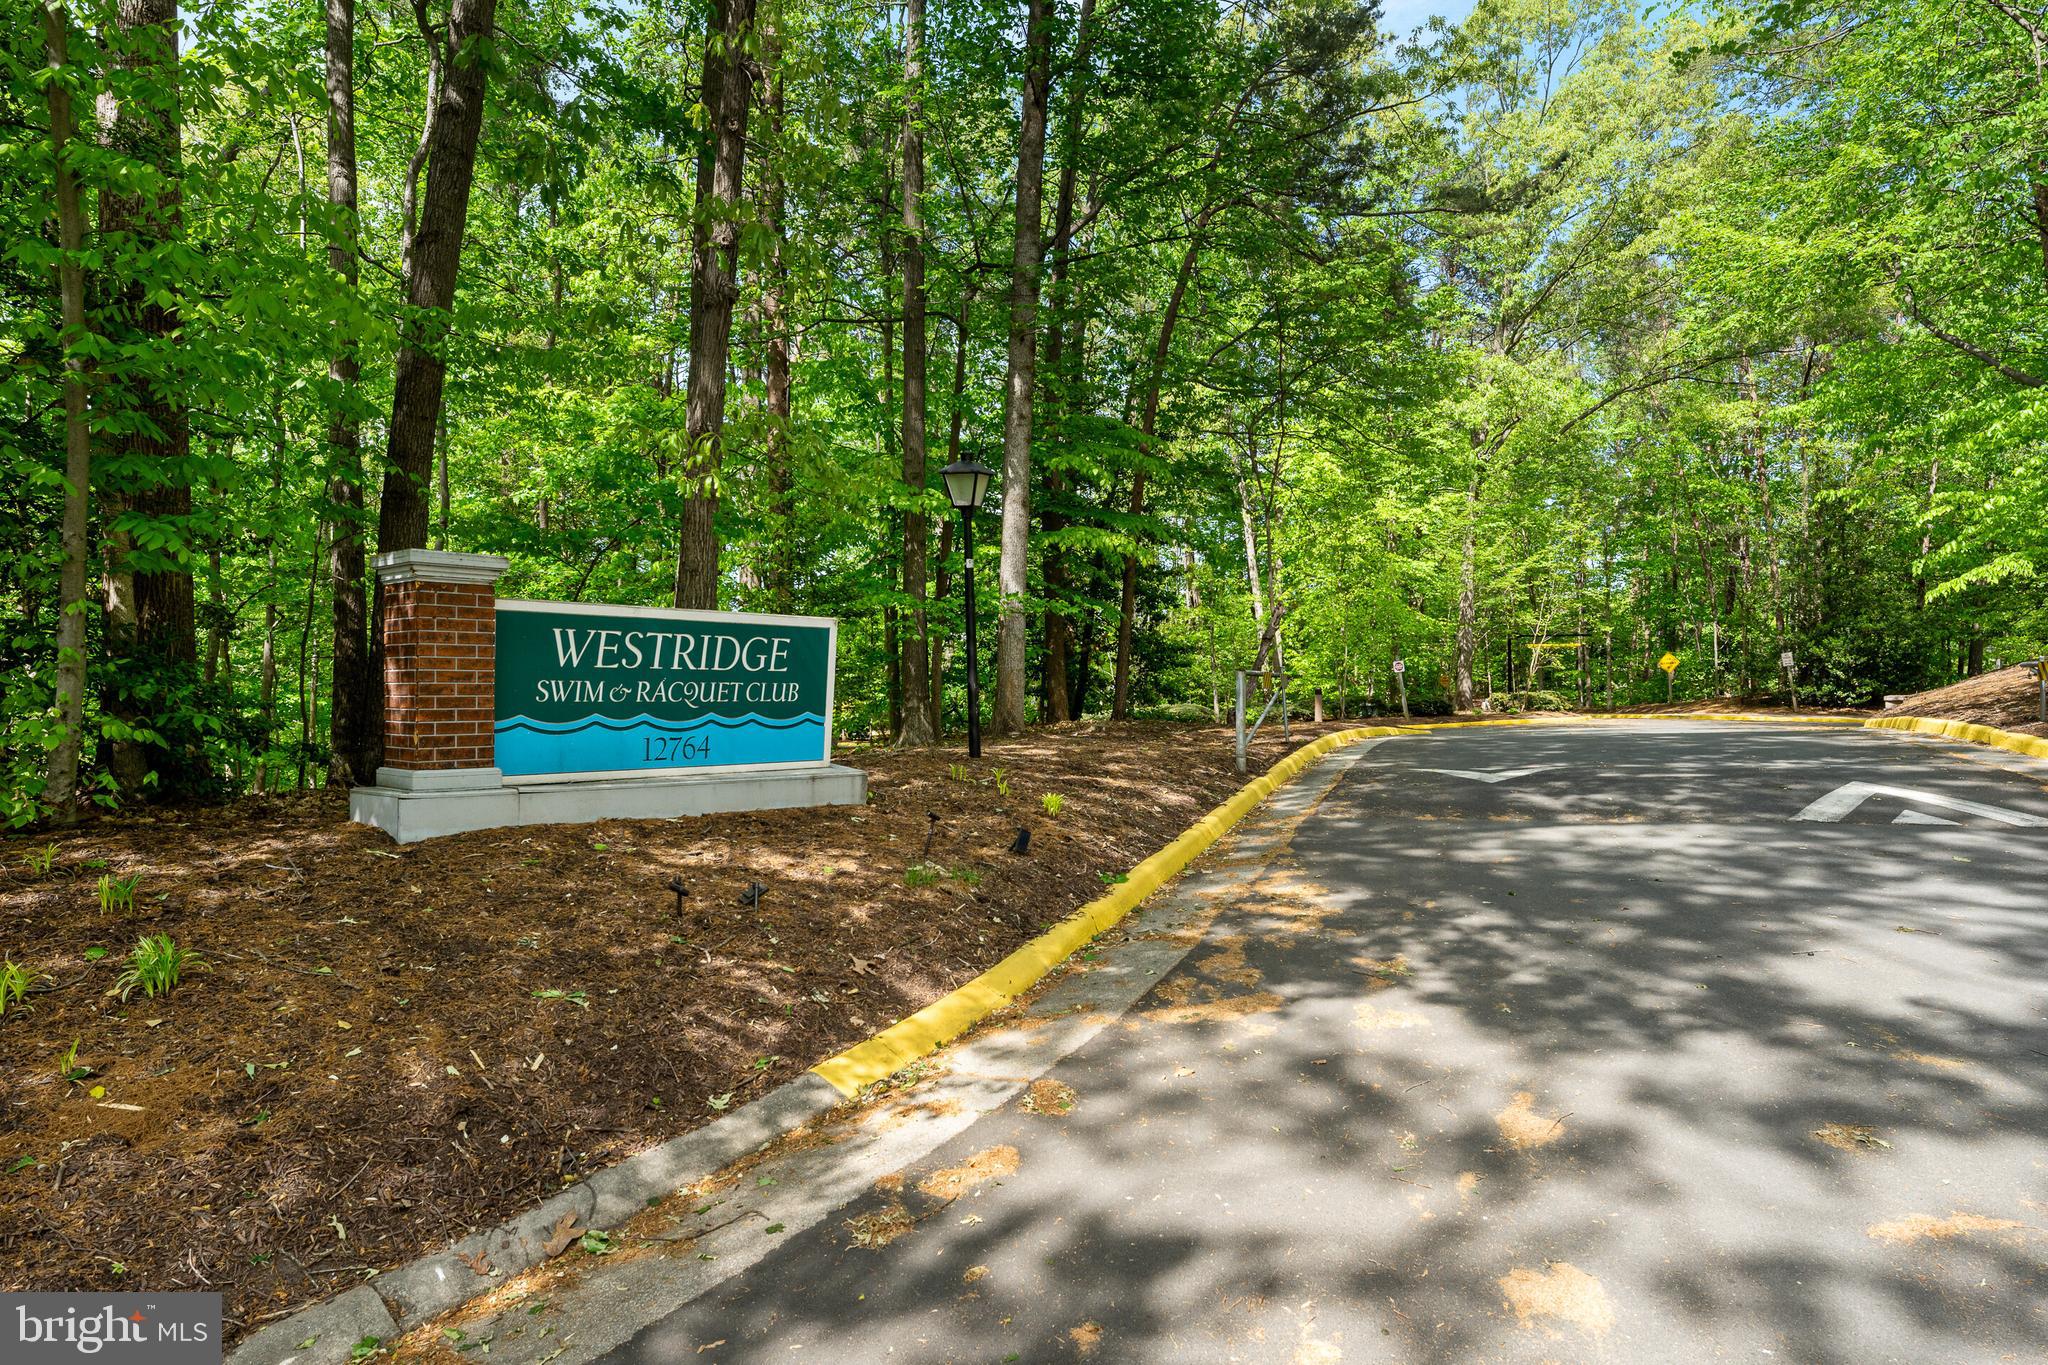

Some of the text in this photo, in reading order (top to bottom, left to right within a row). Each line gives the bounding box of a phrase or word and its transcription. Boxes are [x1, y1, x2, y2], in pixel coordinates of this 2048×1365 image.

[552, 628, 791, 672] WESTRIDGE
[536, 679, 800, 708] SWIM & RACQUET CLUB
[642, 735, 711, 762] 12764
